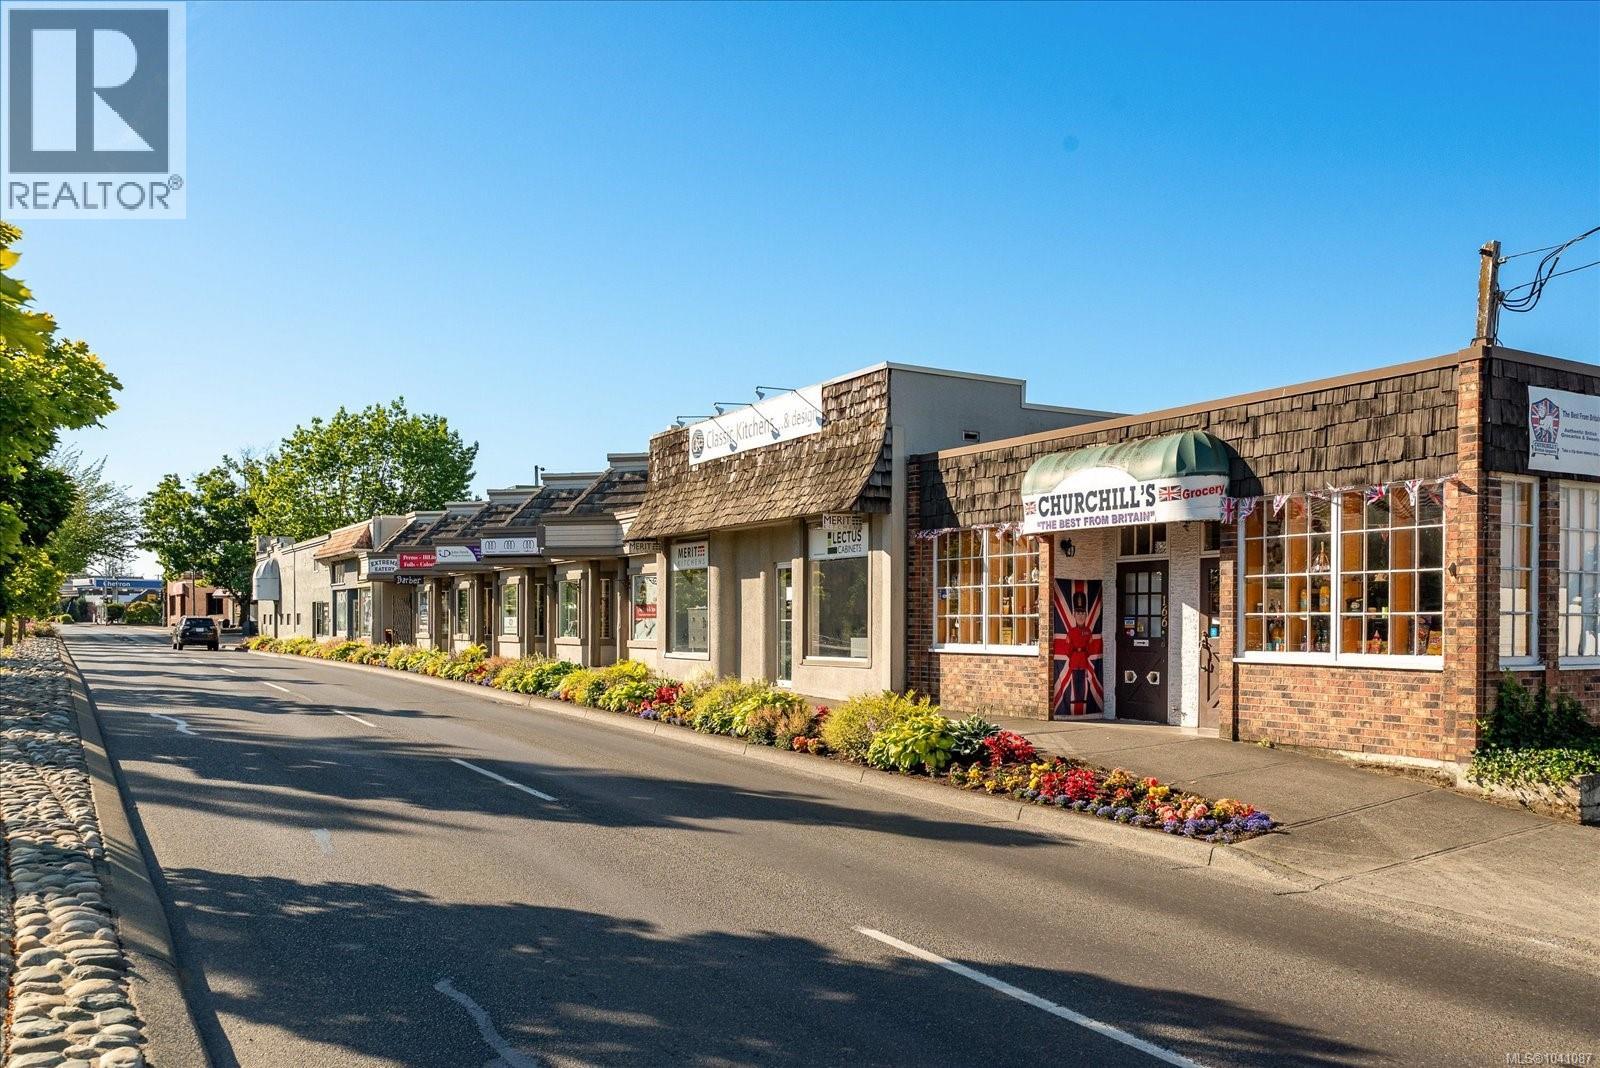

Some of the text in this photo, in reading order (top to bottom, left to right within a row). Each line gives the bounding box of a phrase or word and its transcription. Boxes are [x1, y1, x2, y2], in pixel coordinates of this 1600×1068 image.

[706, 427, 734, 449] Classic
[736, 418, 774, 441] Kitchens
[792, 408, 817, 428] design
[1182, 485, 1225, 500] Grocery
[1038, 483, 1156, 517] CHURCHILL'S
[823, 515, 852, 525] MERIT
[1059, 517, 1080, 529] BEST
[1083, 514, 1110, 526] FROM
[832, 530, 862, 544] LECTUS
[629, 542, 651, 551] MERIT
[677, 545, 698, 559] MERIT
[837, 544, 862, 554] CABINETS
[396, 575, 422, 585] Barber
